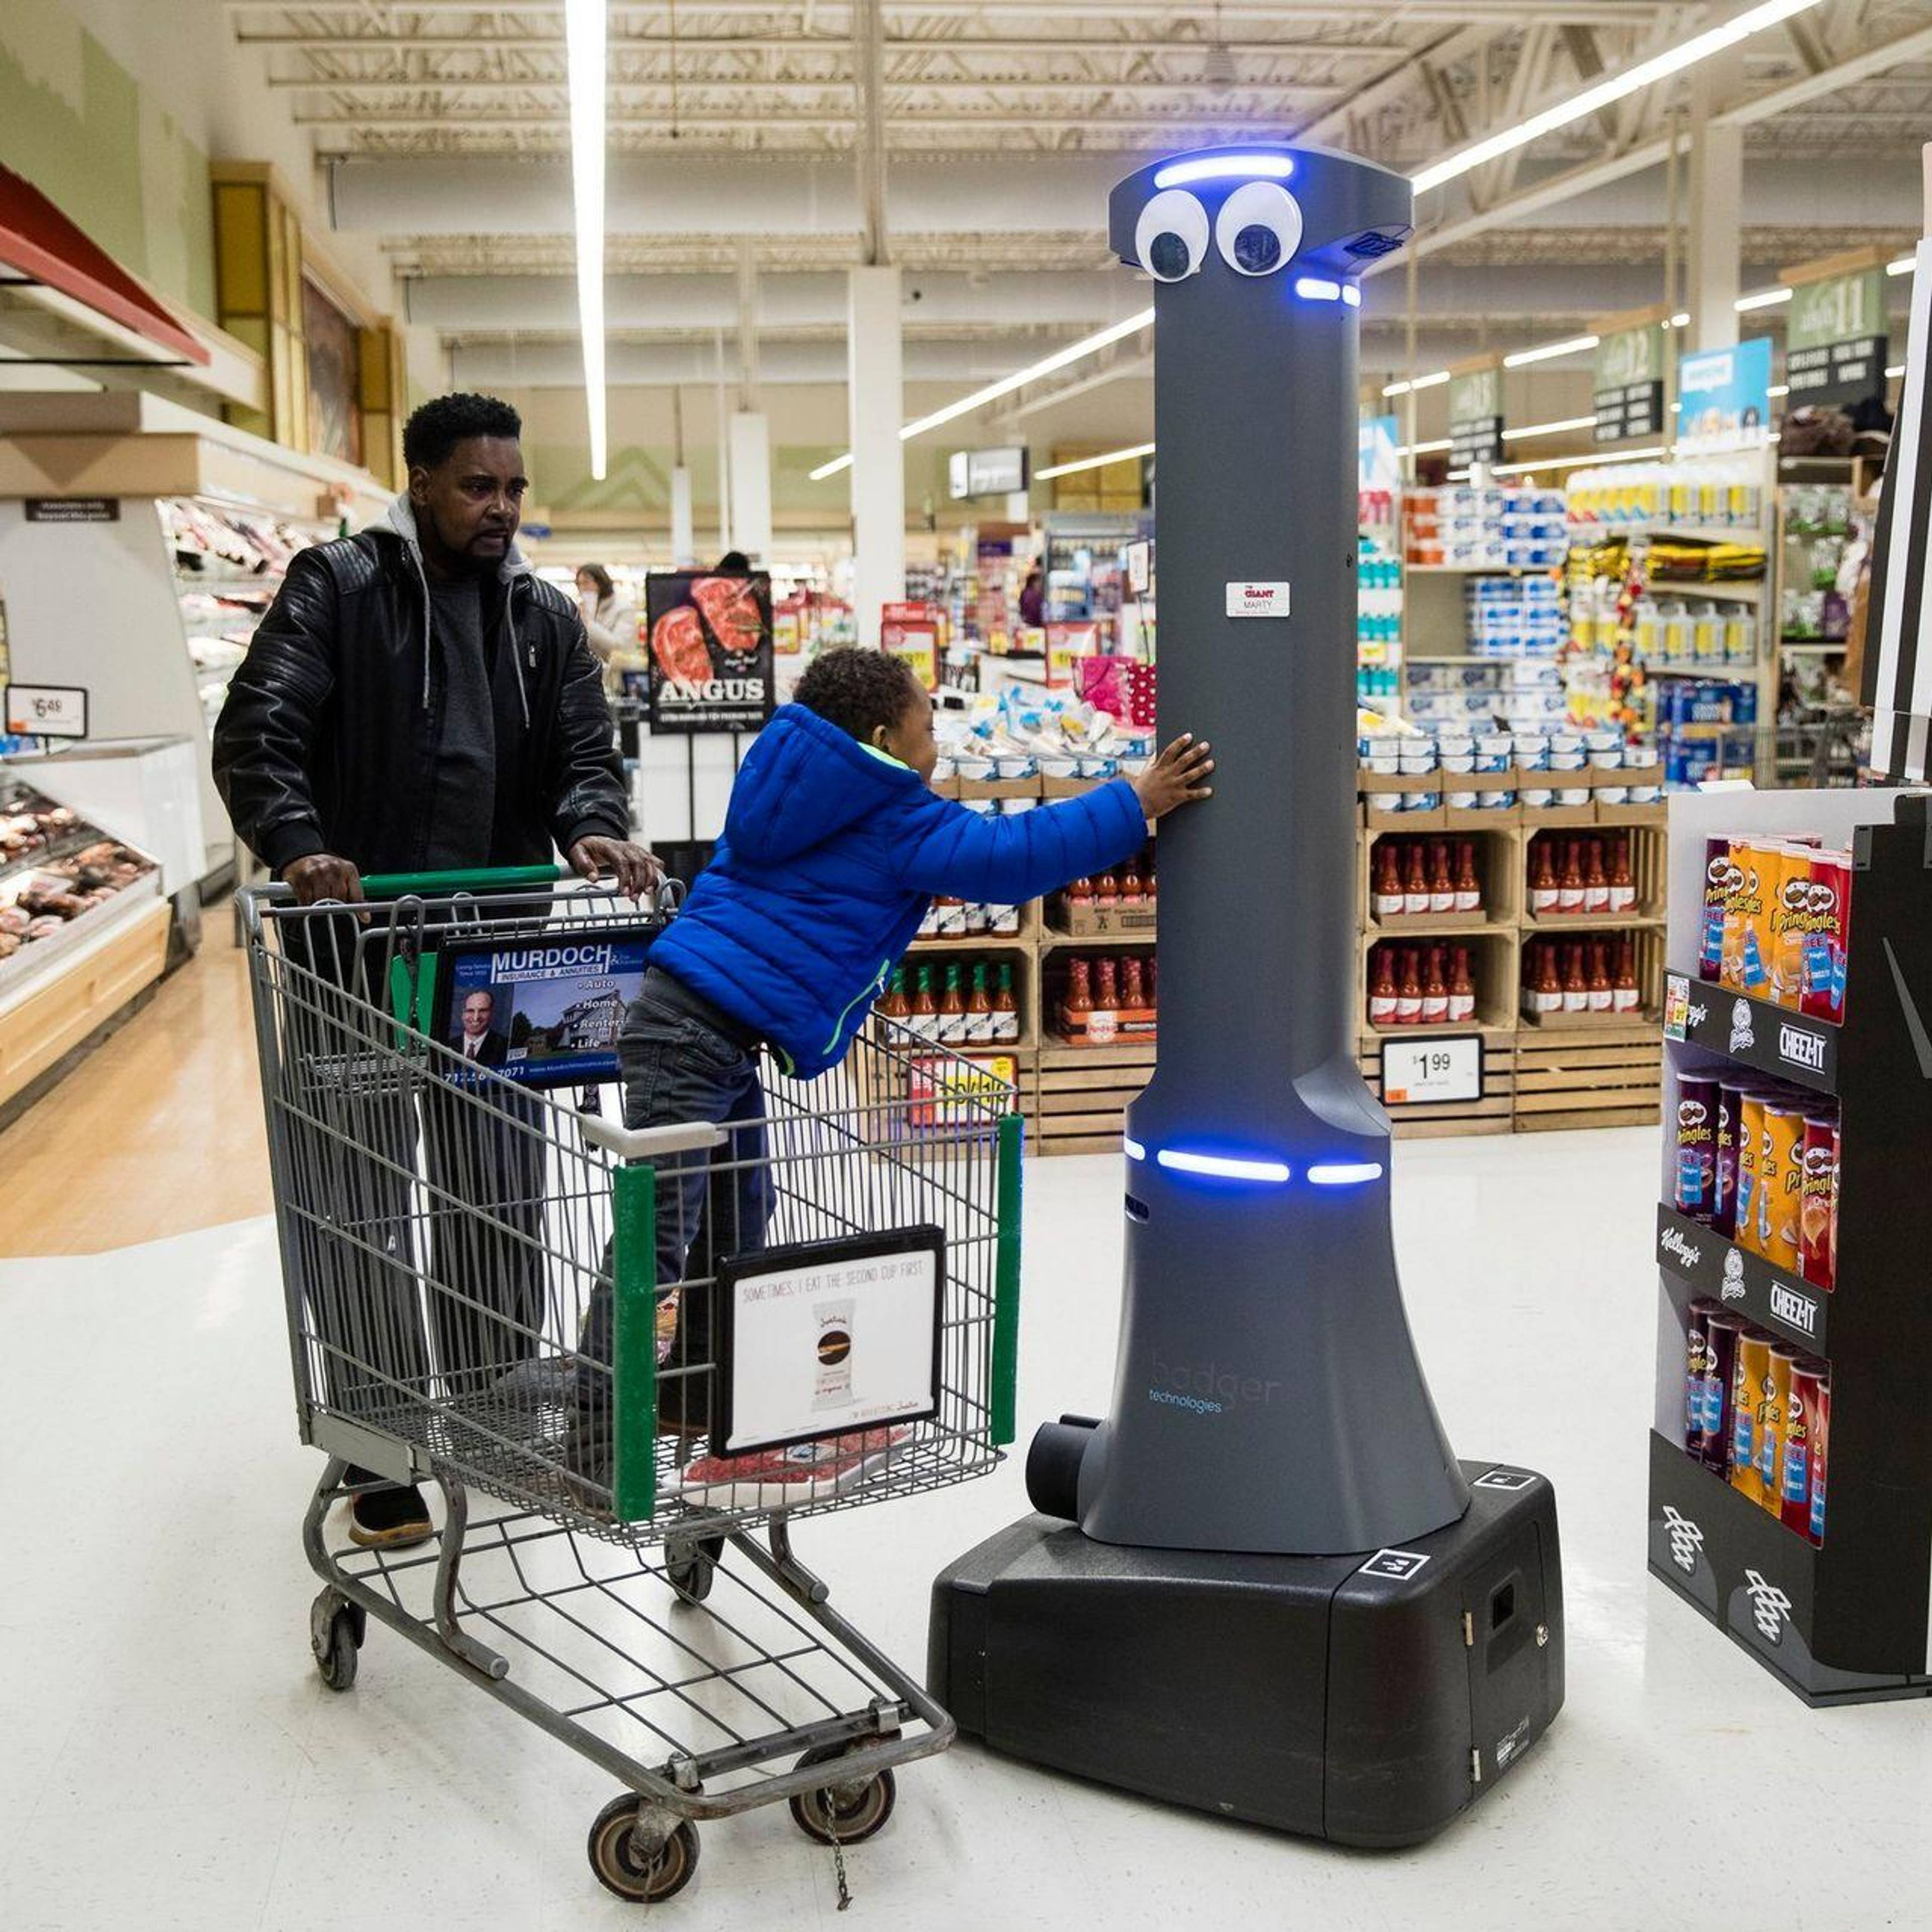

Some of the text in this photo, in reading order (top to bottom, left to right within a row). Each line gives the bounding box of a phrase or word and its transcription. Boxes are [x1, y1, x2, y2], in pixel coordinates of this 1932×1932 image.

[1836, 278, 1863, 336] 11
[1245, 590, 1274, 598] GIANT
[1244, 601, 1272, 609] MARTY
[658, 678, 765, 701] ANGUS
[1705, 887, 1729, 908] Pring
[490, 944, 611, 984] MURDOCH
[502, 965, 601, 981] INSURANCE & ANNUITIES
[586, 980, 615, 989] Auto
[584, 1000, 618, 1009] Home
[578, 1038, 601, 1048] Life
[1677, 1126, 1712, 1145] ringles
[1661, 1226, 1702, 1268] Kellogg's
[806, 1275, 821, 1292] EAT
[826, 1271, 842, 1289] THE
[846, 1267, 878, 1286] SECOND
[881, 1264, 897, 1281] CUP
[1149, 1389, 1223, 1414] technologies
